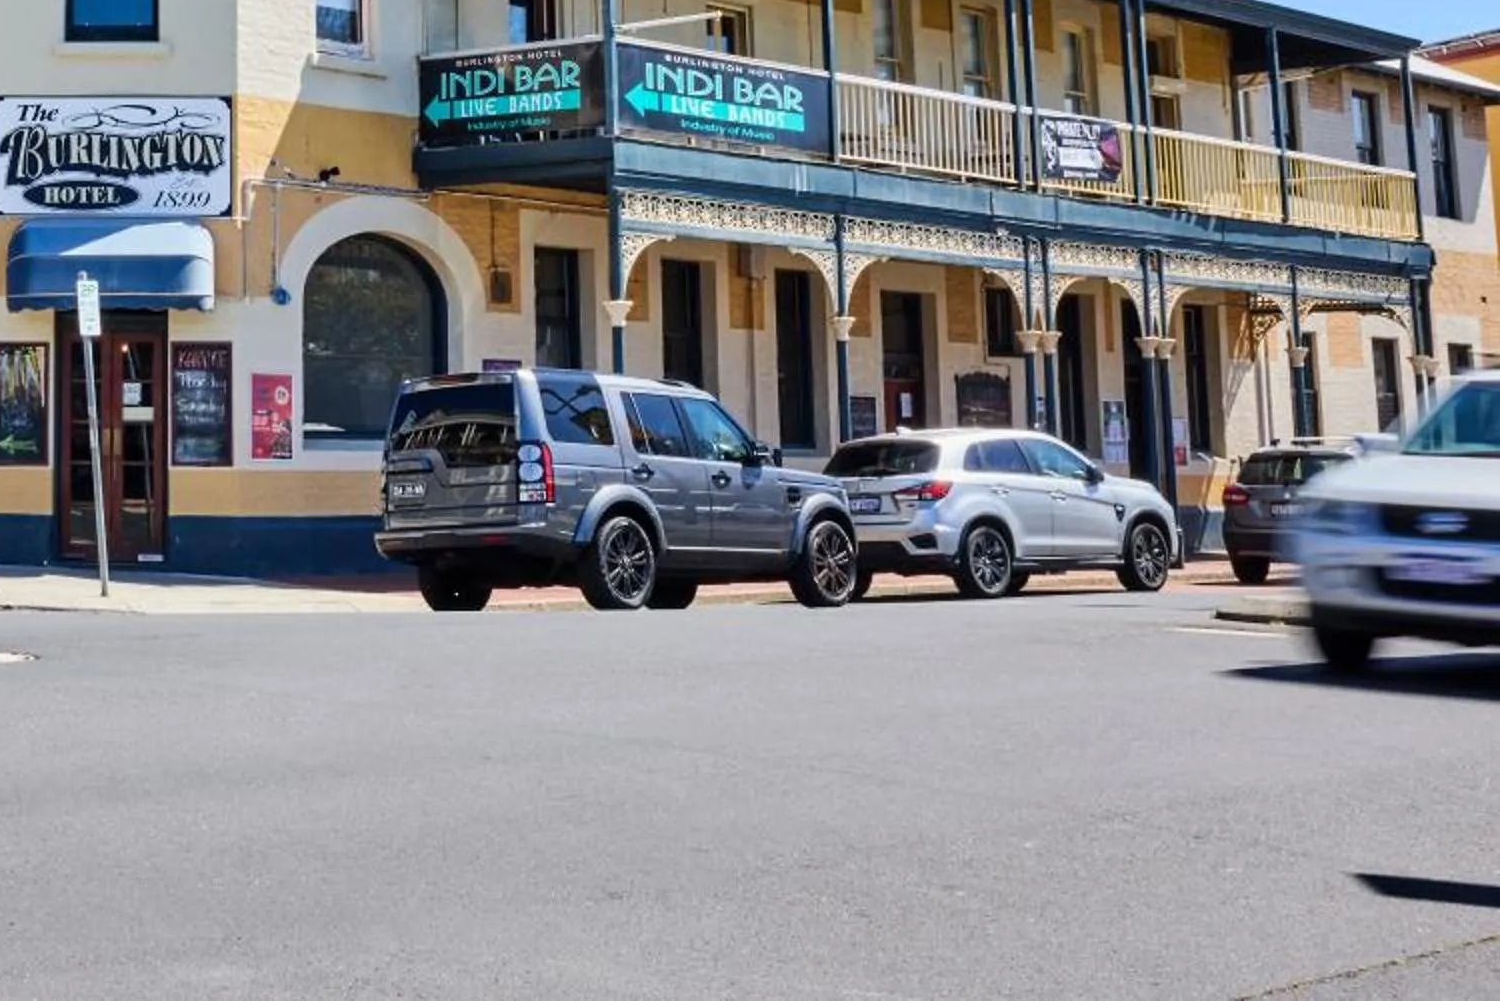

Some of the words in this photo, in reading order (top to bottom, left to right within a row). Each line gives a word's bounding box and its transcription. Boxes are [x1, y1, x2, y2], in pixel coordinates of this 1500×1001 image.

[455, 53, 523, 68] BURLINGTON
[527, 50, 563, 60] HOTEL
[663, 54, 744, 75] BURLINGTON
[747, 68, 786, 81] HOTEL
[441, 66, 505, 99] INDI
[514, 60, 581, 92] BAR
[645, 62, 723, 100] INDI
[733, 76, 805, 112] BAR
[17, 103, 60, 122] The
[460, 97, 497, 118] LIVE
[509, 91, 563, 113] BANDS
[670, 96, 715, 119] LIVE
[727, 104, 785, 129] BANDS
[681, 119, 726, 136] Industry
[43, 186, 121, 205] HOTEL
[153, 190, 211, 209] 1899
